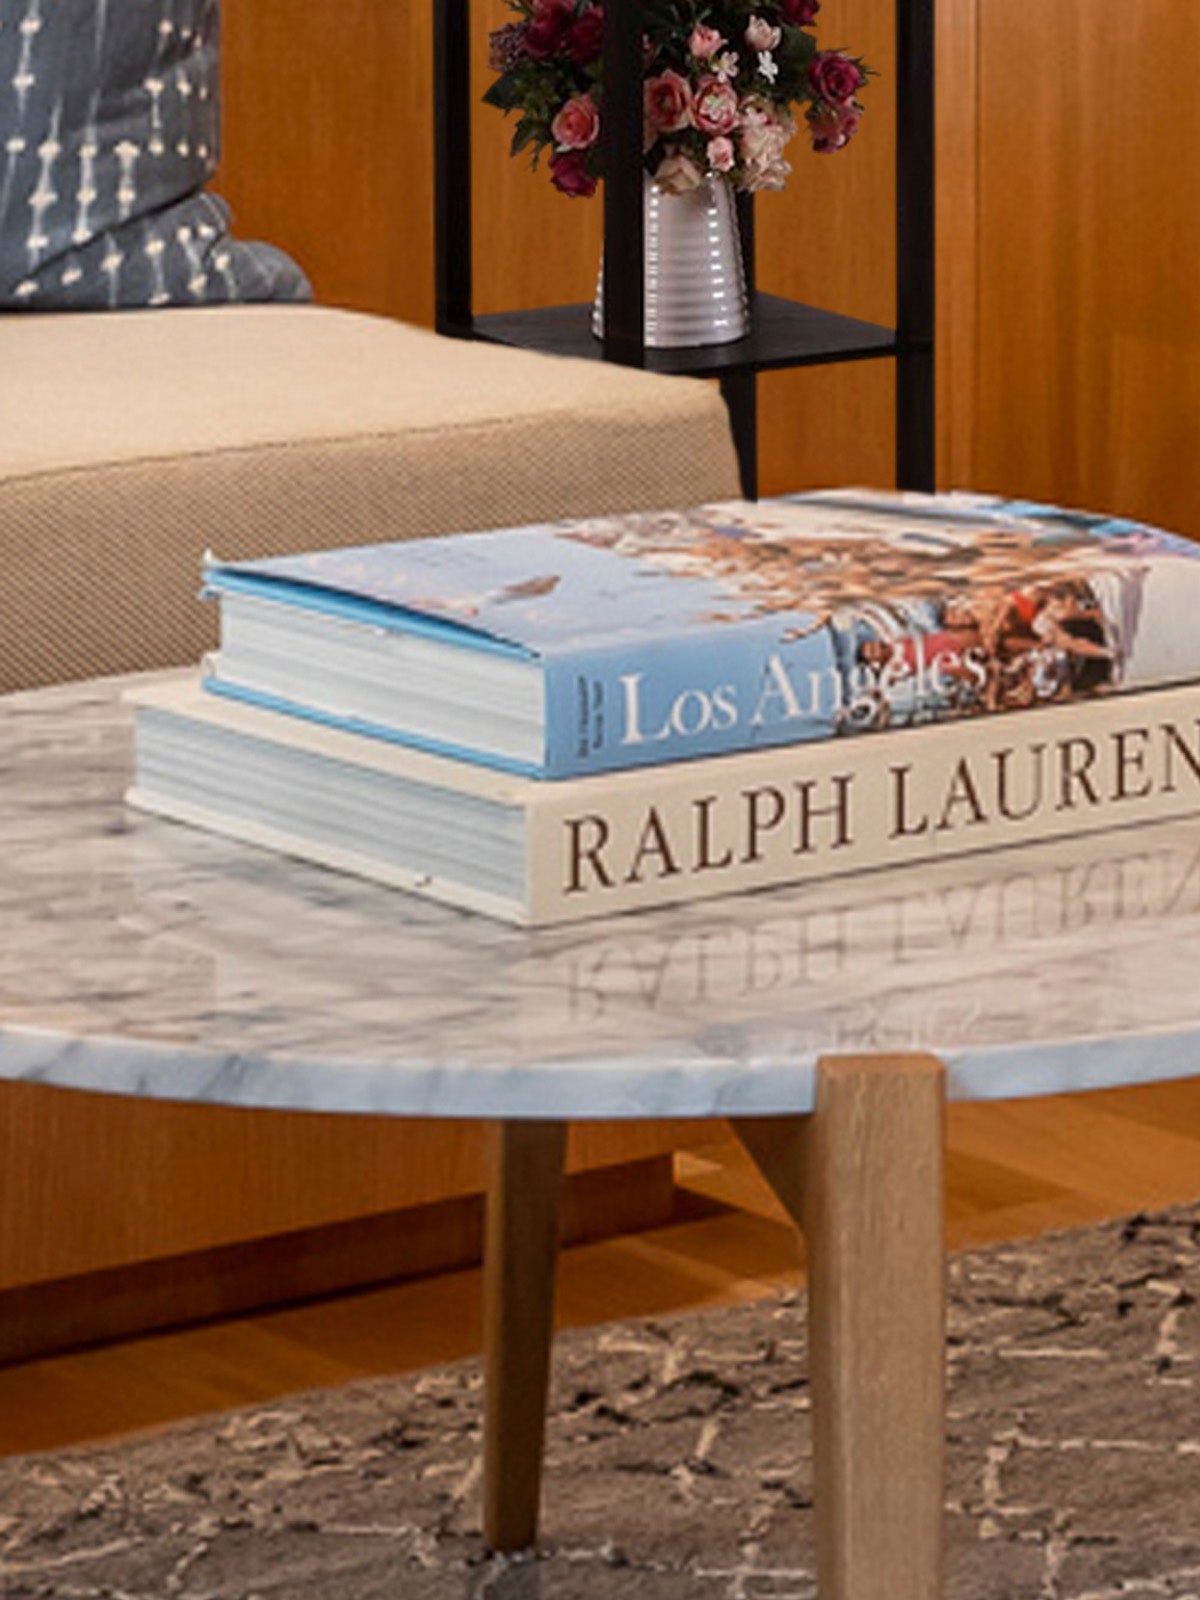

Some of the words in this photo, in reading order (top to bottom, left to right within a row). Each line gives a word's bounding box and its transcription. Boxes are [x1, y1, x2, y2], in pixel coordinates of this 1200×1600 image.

[618, 671, 738, 746] Los
[749, 640, 989, 727] Angeles
[563, 771, 853, 895] RALPH
